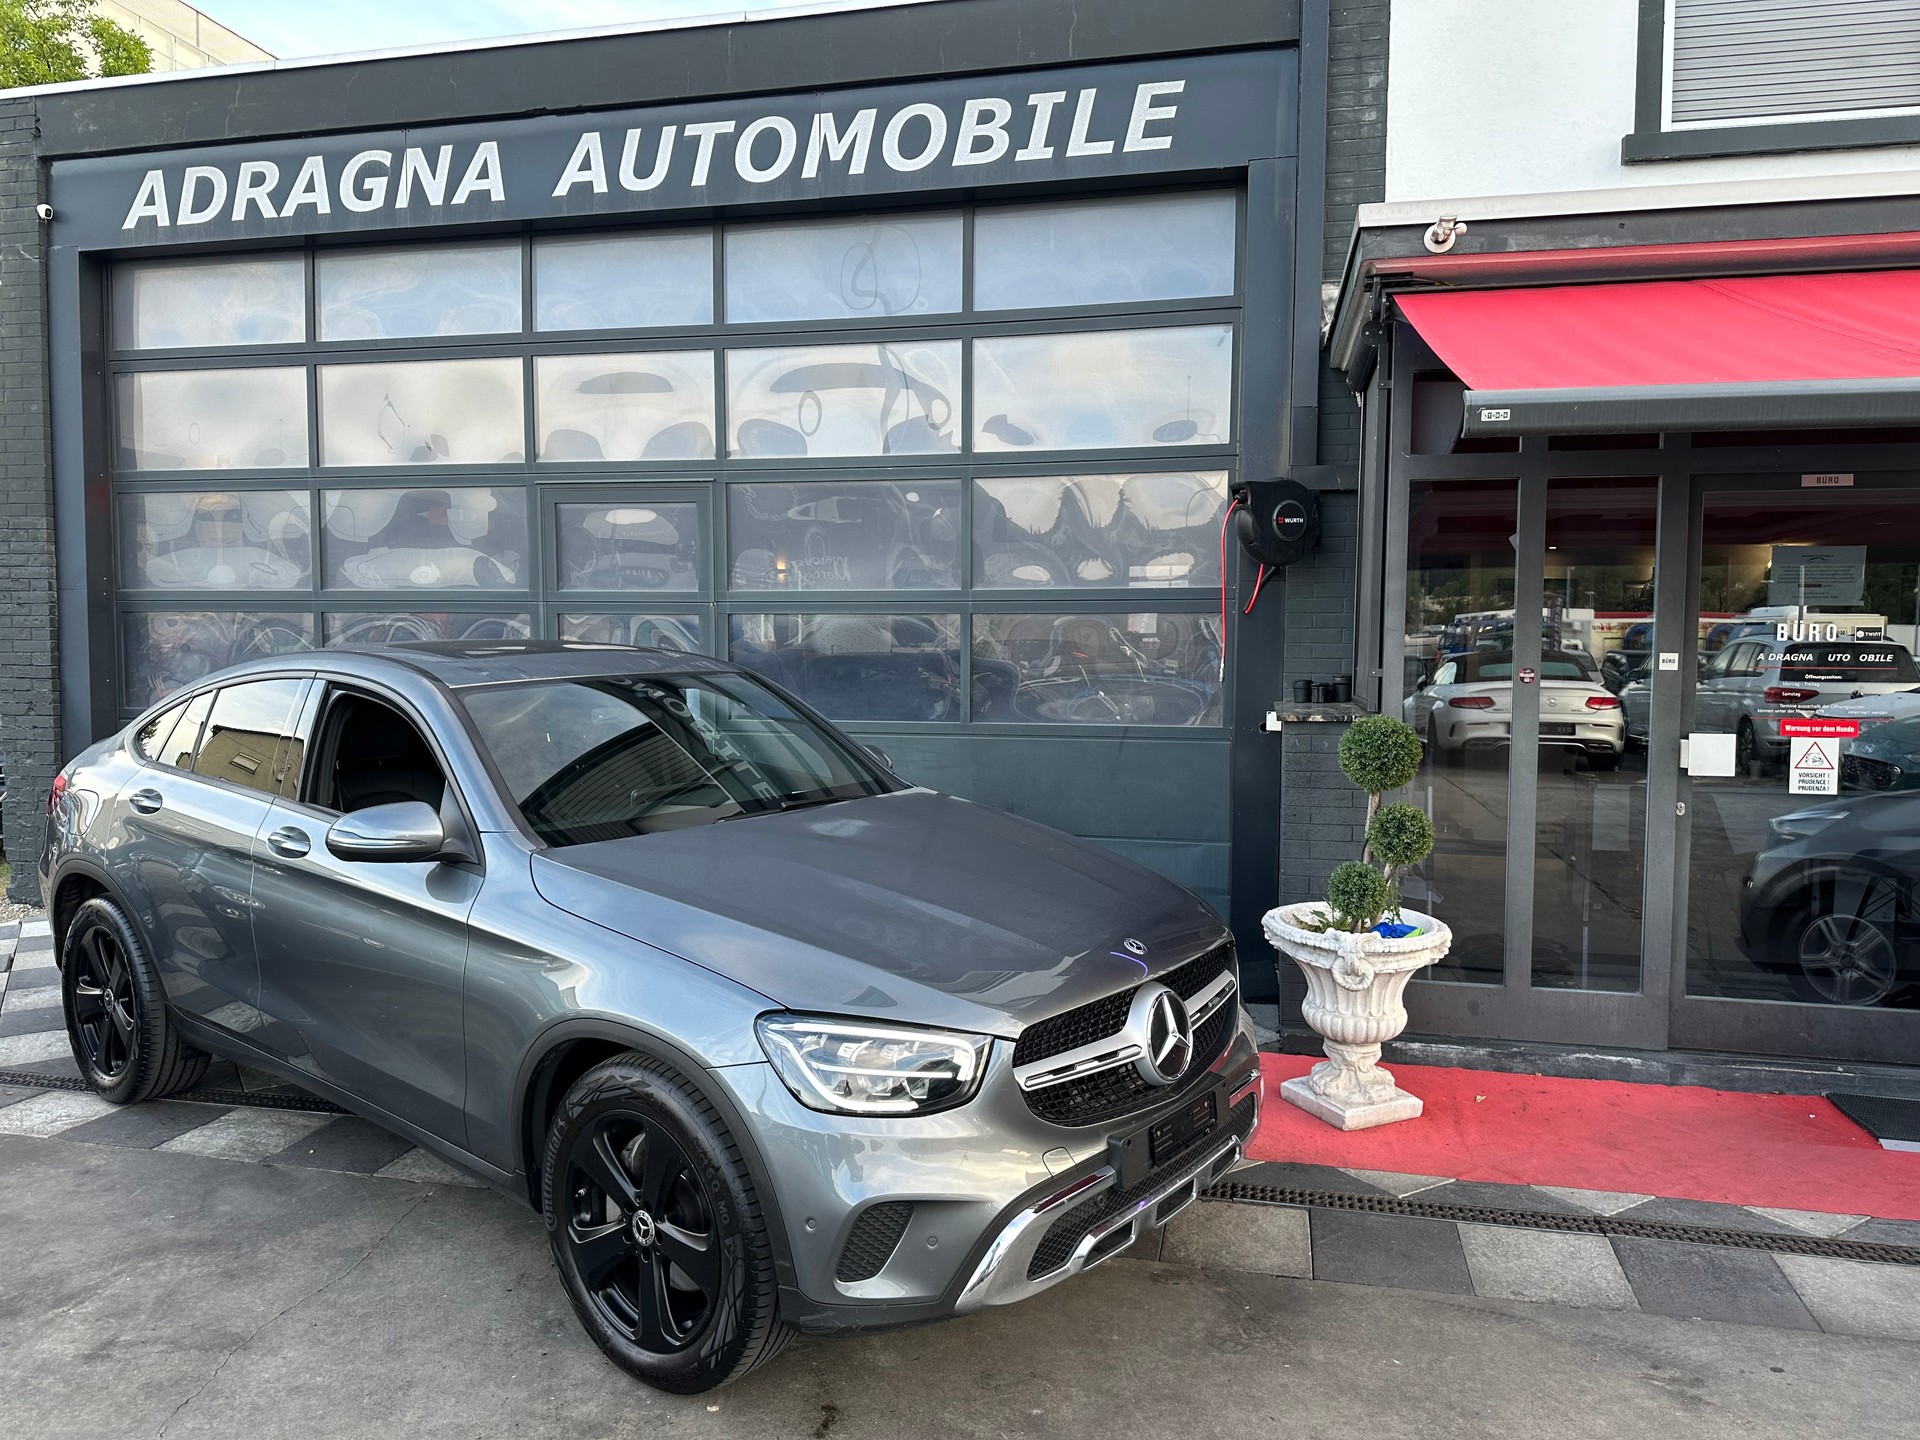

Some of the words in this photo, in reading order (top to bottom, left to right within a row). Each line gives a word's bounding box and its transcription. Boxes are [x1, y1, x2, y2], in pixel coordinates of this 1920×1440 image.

[122, 140, 506, 230] ADRAGNA
[552, 80, 1186, 198] AUTOMOBILE
[1816, 475, 1839, 484] BÜRO
[1776, 620, 1837, 642] BÜRO
[1785, 724, 1811, 733] Warnung
[1836, 725, 1855, 733] Hunde
[542, 1127, 564, 1233] Continental
